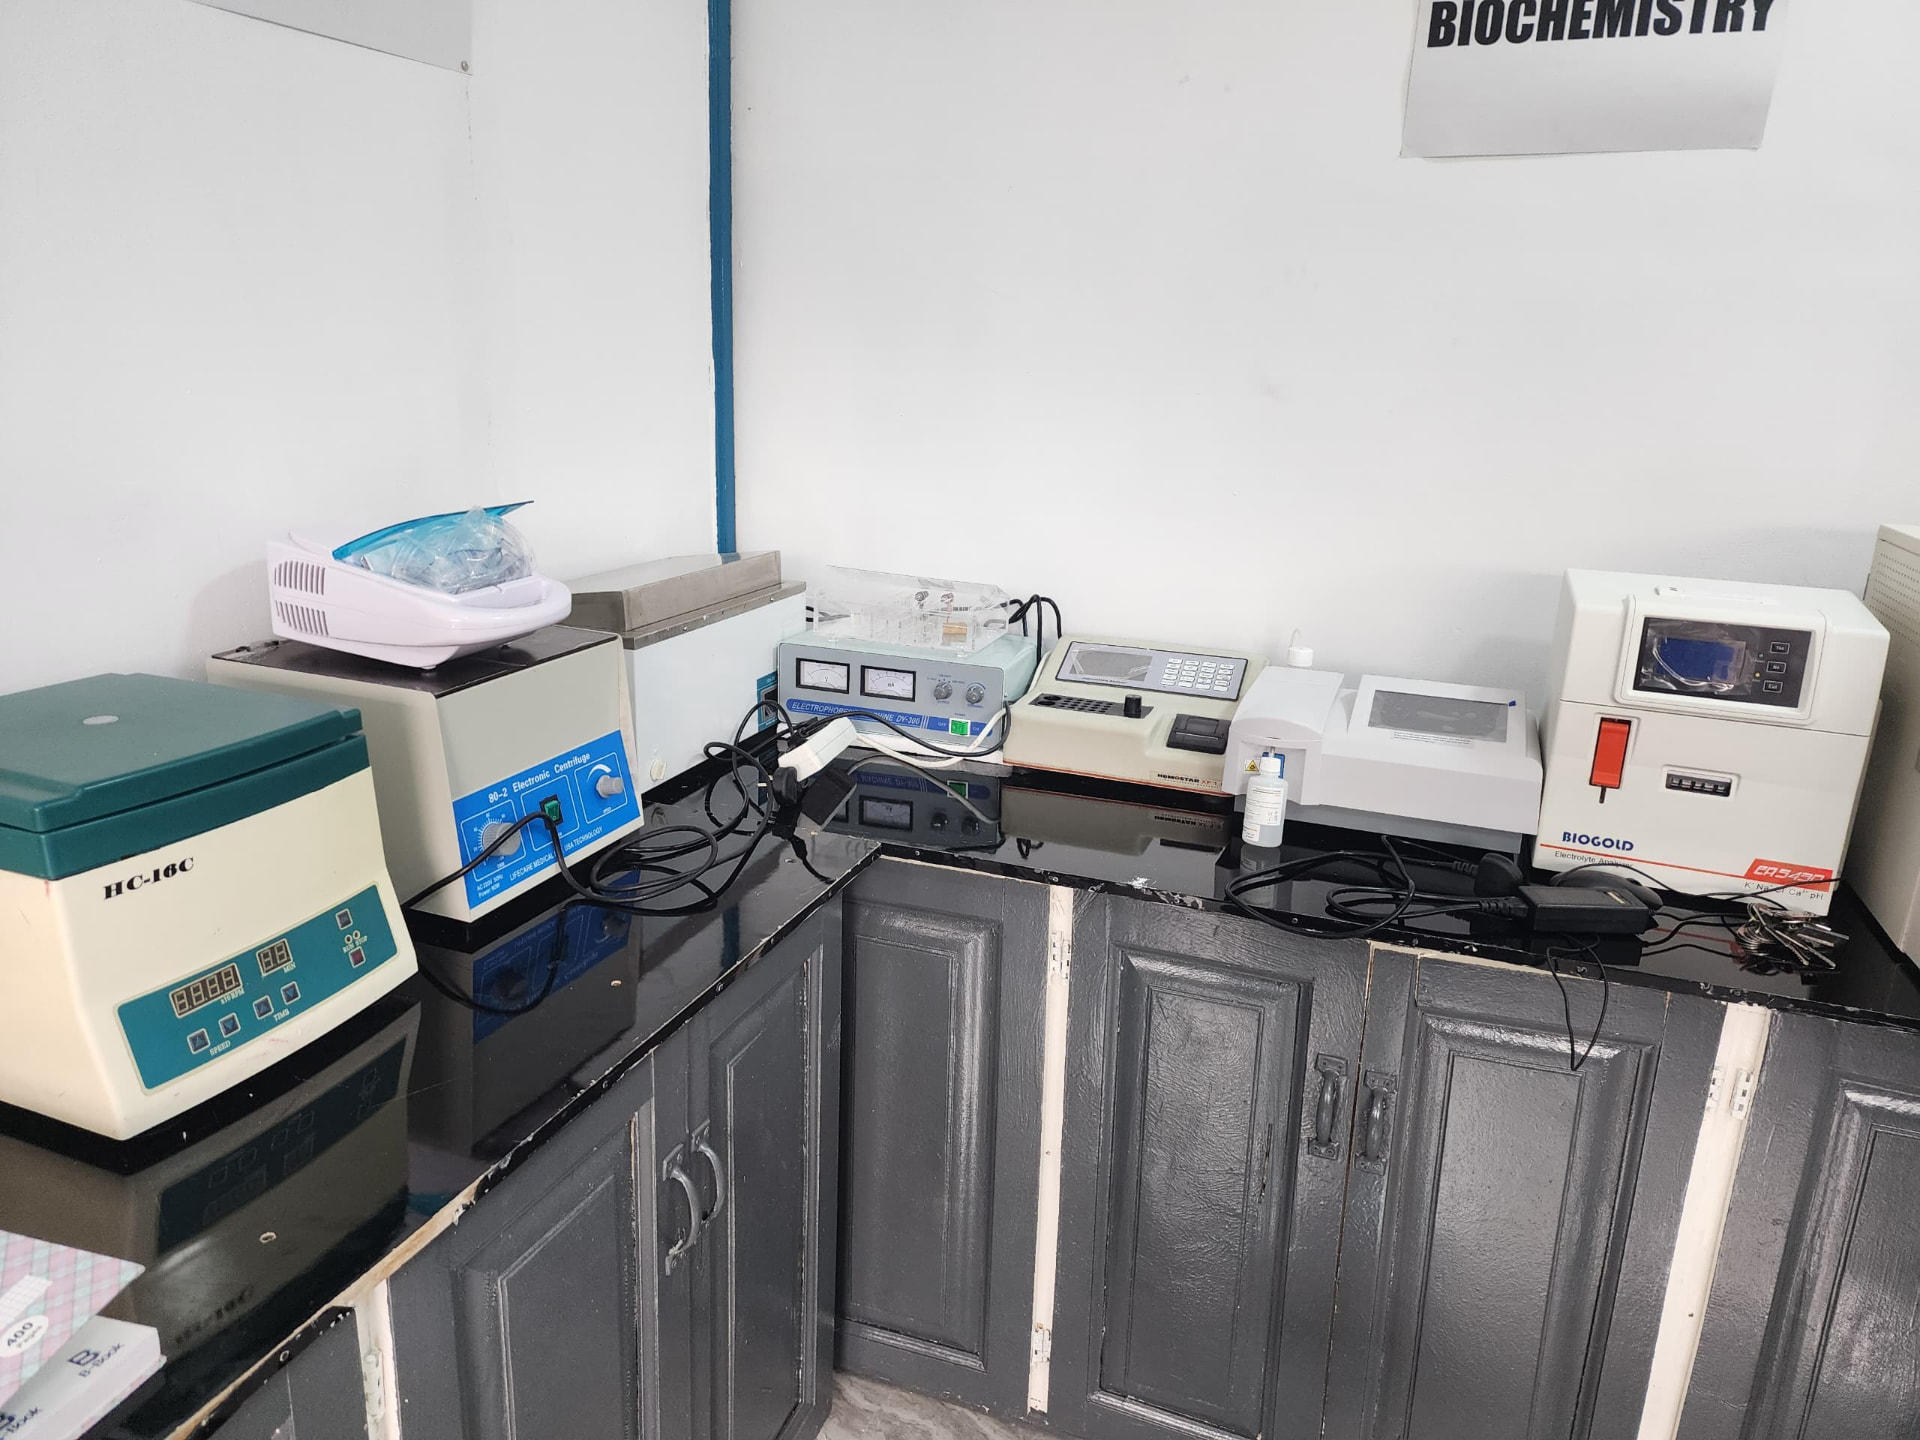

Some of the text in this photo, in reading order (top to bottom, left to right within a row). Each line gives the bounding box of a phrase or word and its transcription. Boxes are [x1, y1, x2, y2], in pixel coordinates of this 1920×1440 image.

[1427, 0, 1774, 48] BIOCHEMISTRY
[488, 752, 591, 804] 80-2 Electronic Centrifuge
[574, 826, 603, 846] TECHNOLOGY
[1562, 831, 1634, 851] BIOGOLD
[510, 862, 534, 882] LIFECARE
[533, 853, 555, 869] MEDICAL
[1554, 851, 1596, 863] Electrolyte
[103, 857, 194, 900] HC-16C
[210, 1040, 231, 1056] SPEED
[7, 1322, 33, 1347] 400
